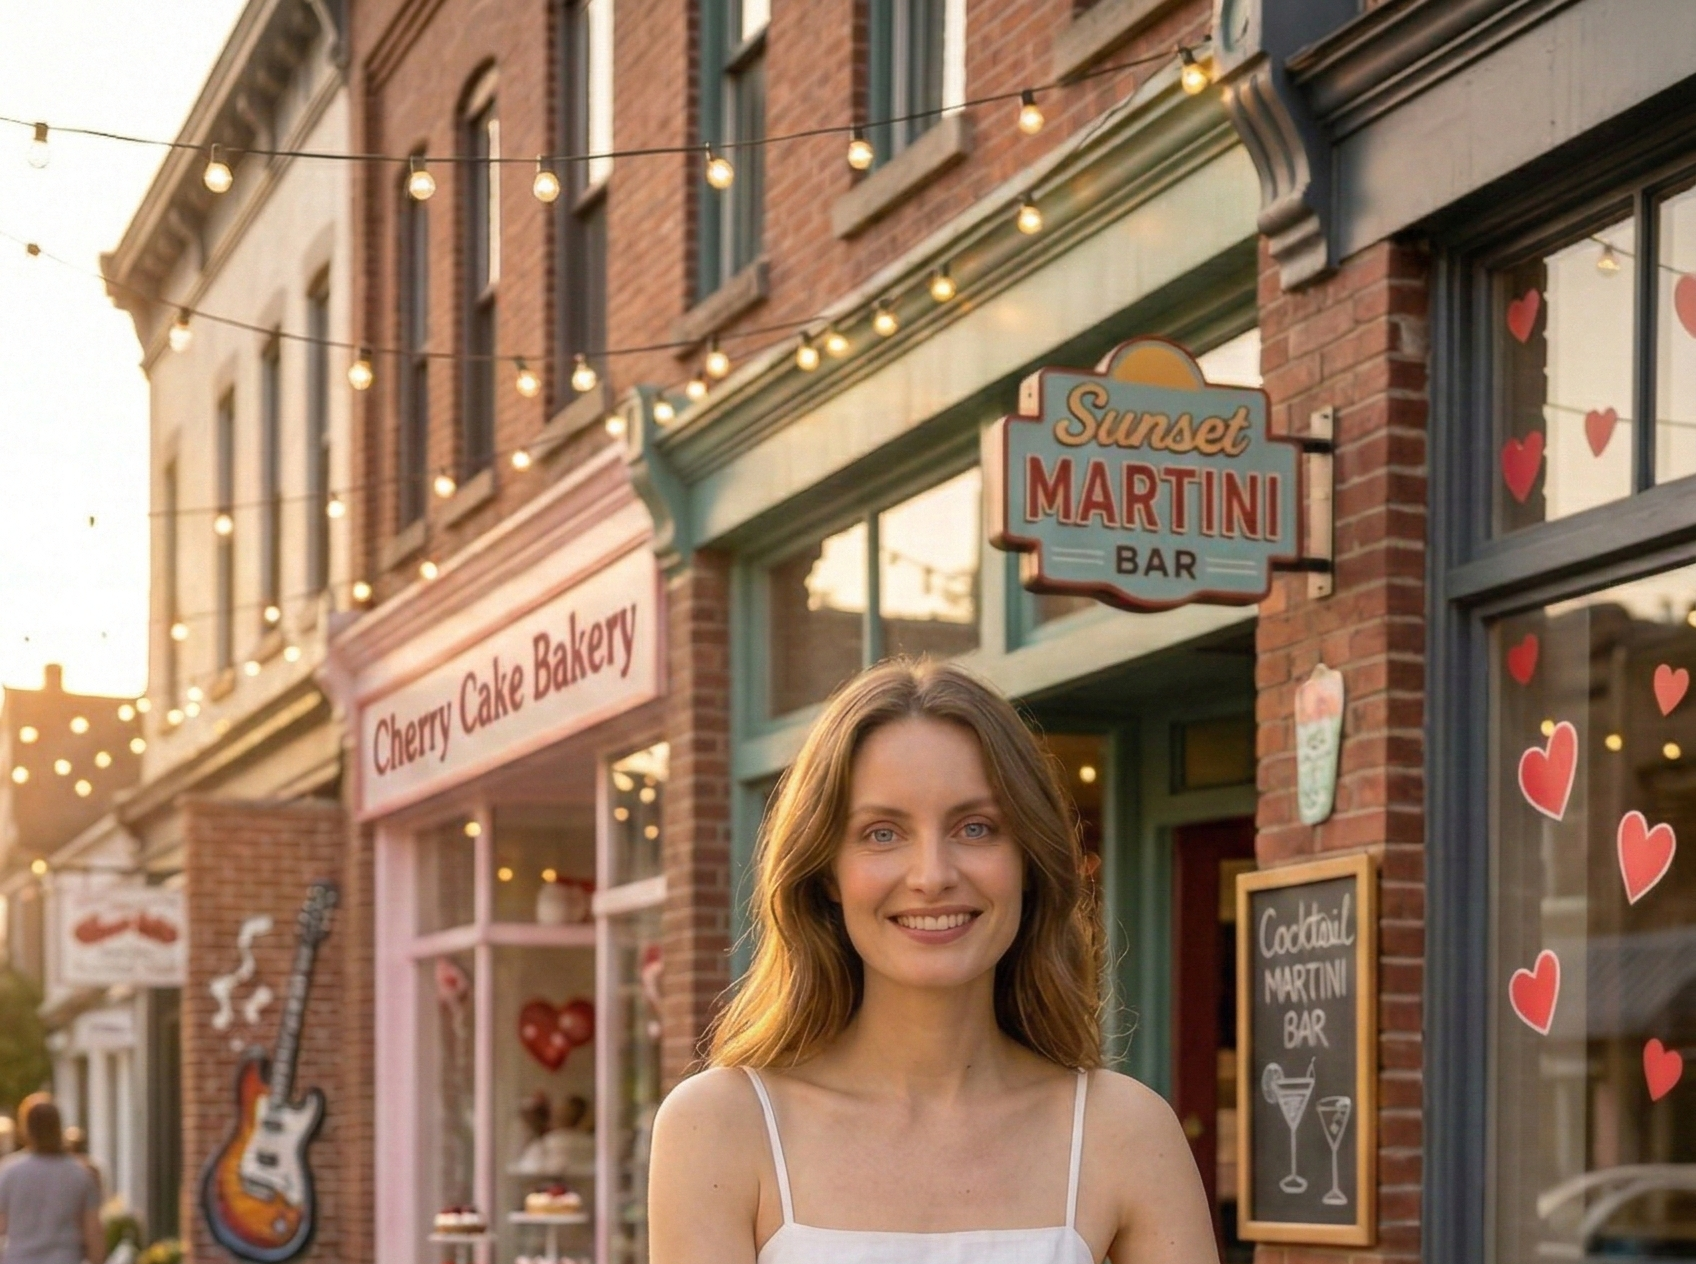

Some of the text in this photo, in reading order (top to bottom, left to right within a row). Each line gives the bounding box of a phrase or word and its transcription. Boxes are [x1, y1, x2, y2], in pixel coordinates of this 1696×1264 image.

[1054, 383, 1251, 457] Sunset
[1025, 454, 1281, 542] MARTINI
[1116, 546, 1198, 580] BAR
[374, 603, 637, 775] Cherry Cake Bakery
[1260, 894, 1355, 958] Cocktail
[1265, 960, 1347, 1004] MARTINI
[1284, 1008, 1329, 1050] BAR
